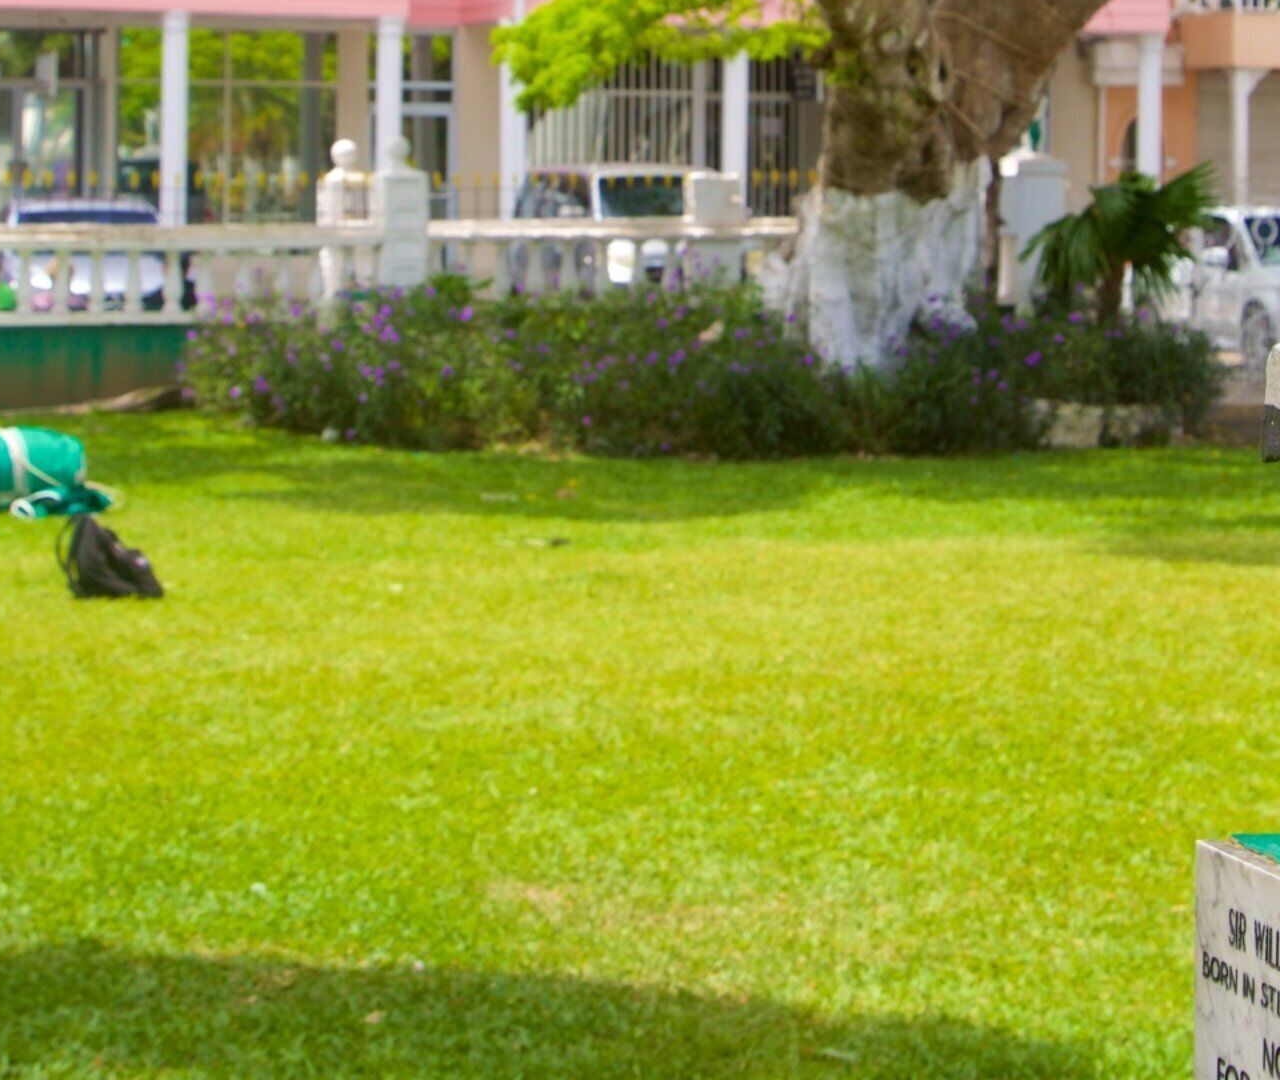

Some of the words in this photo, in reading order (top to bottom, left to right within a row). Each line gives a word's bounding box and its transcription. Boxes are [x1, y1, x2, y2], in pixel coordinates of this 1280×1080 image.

[1228, 908, 1247, 953] SIR
[1202, 951, 1238, 995] BORN
[1243, 972, 1255, 1005] IN
